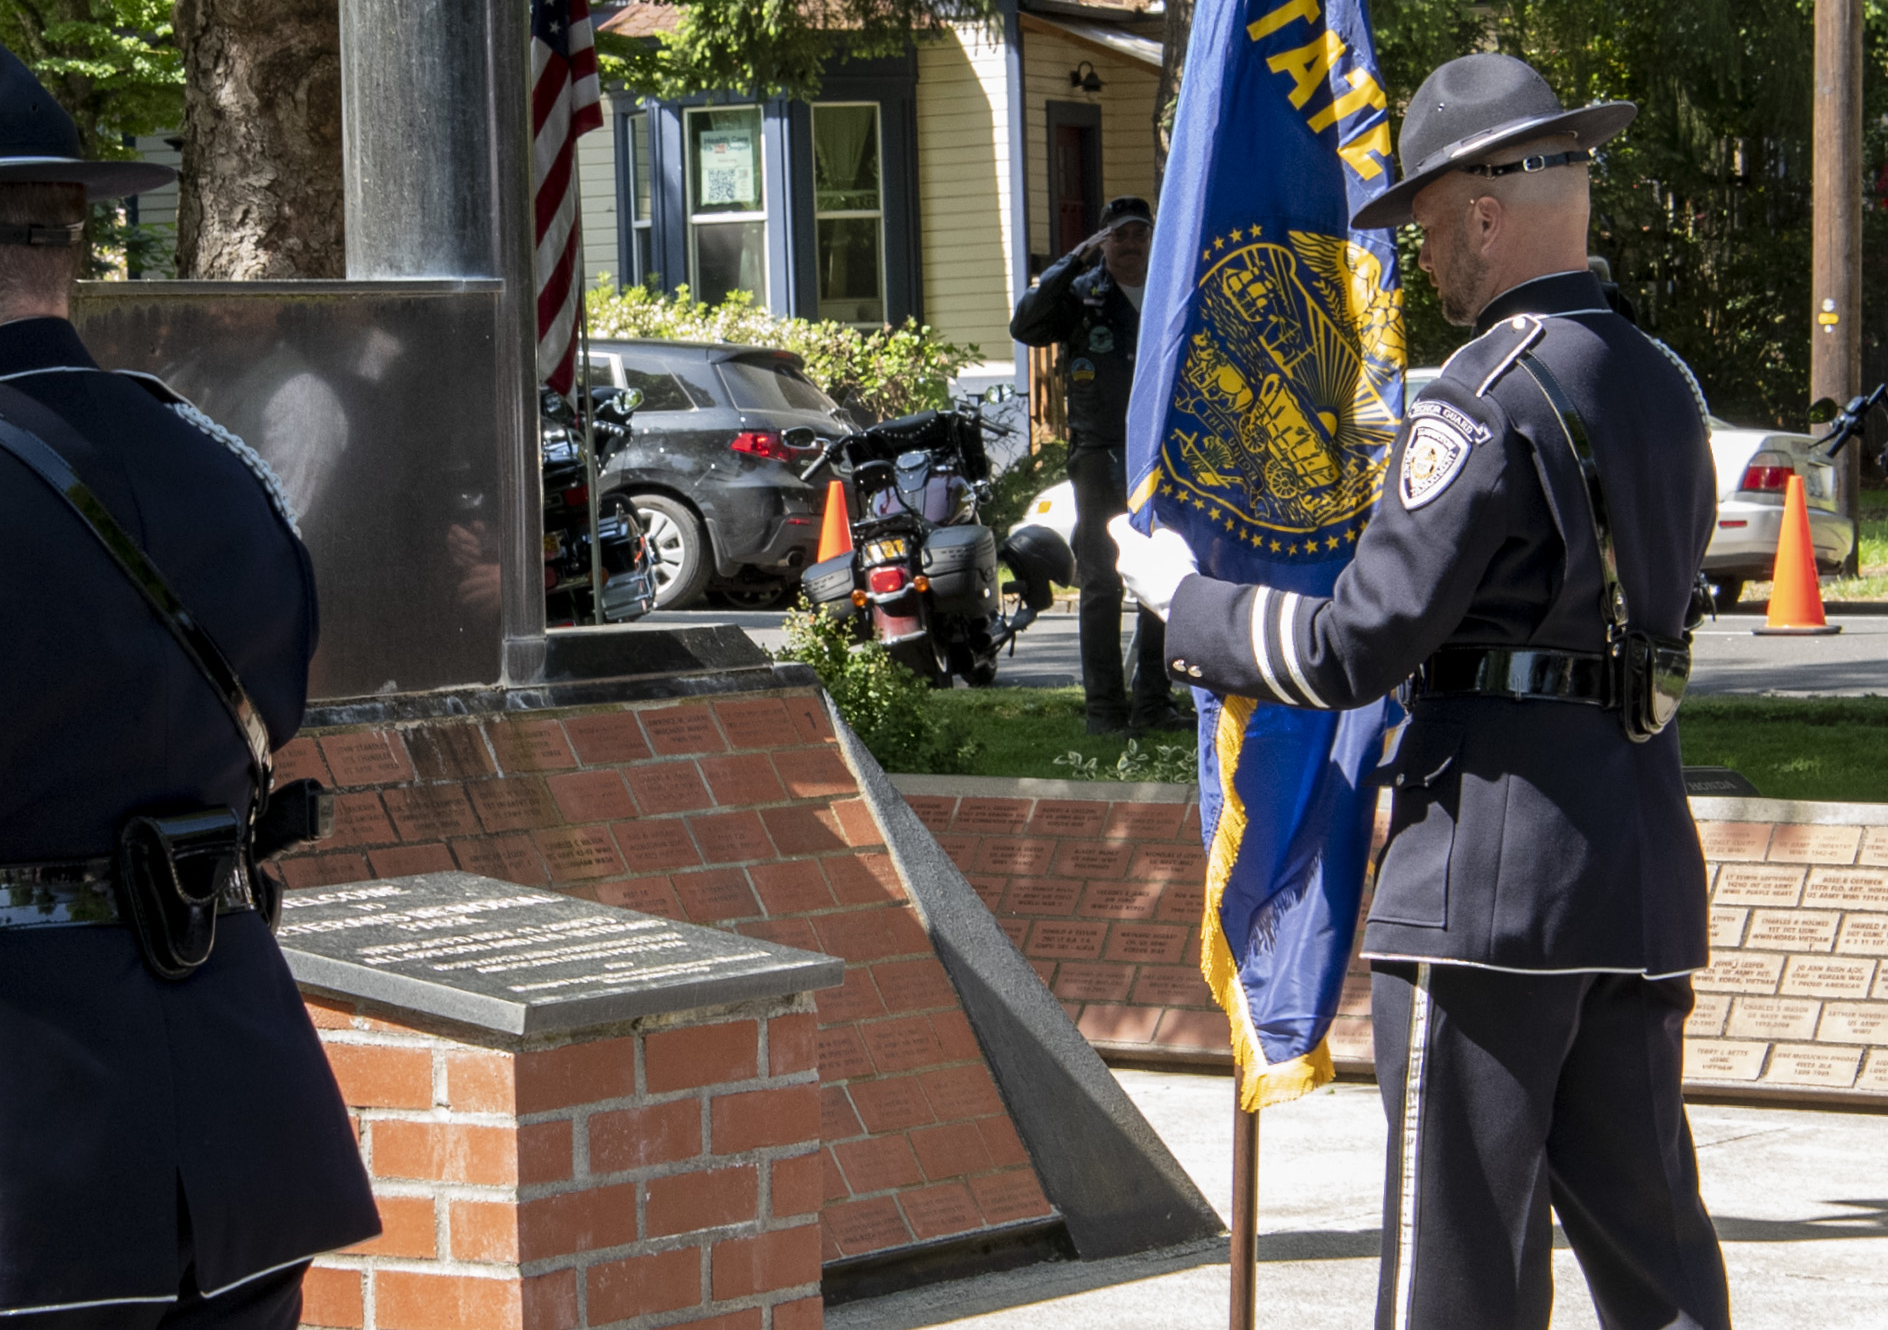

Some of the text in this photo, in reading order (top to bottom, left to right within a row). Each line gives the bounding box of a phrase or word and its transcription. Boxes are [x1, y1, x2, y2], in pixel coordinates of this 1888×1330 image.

[1442, 409, 1472, 434] GUARD
[1201, 409, 1258, 481] THE UNION
[279, 885, 412, 909] ELCOME
[277, 894, 565, 938] ETERANS MEMORIAL
